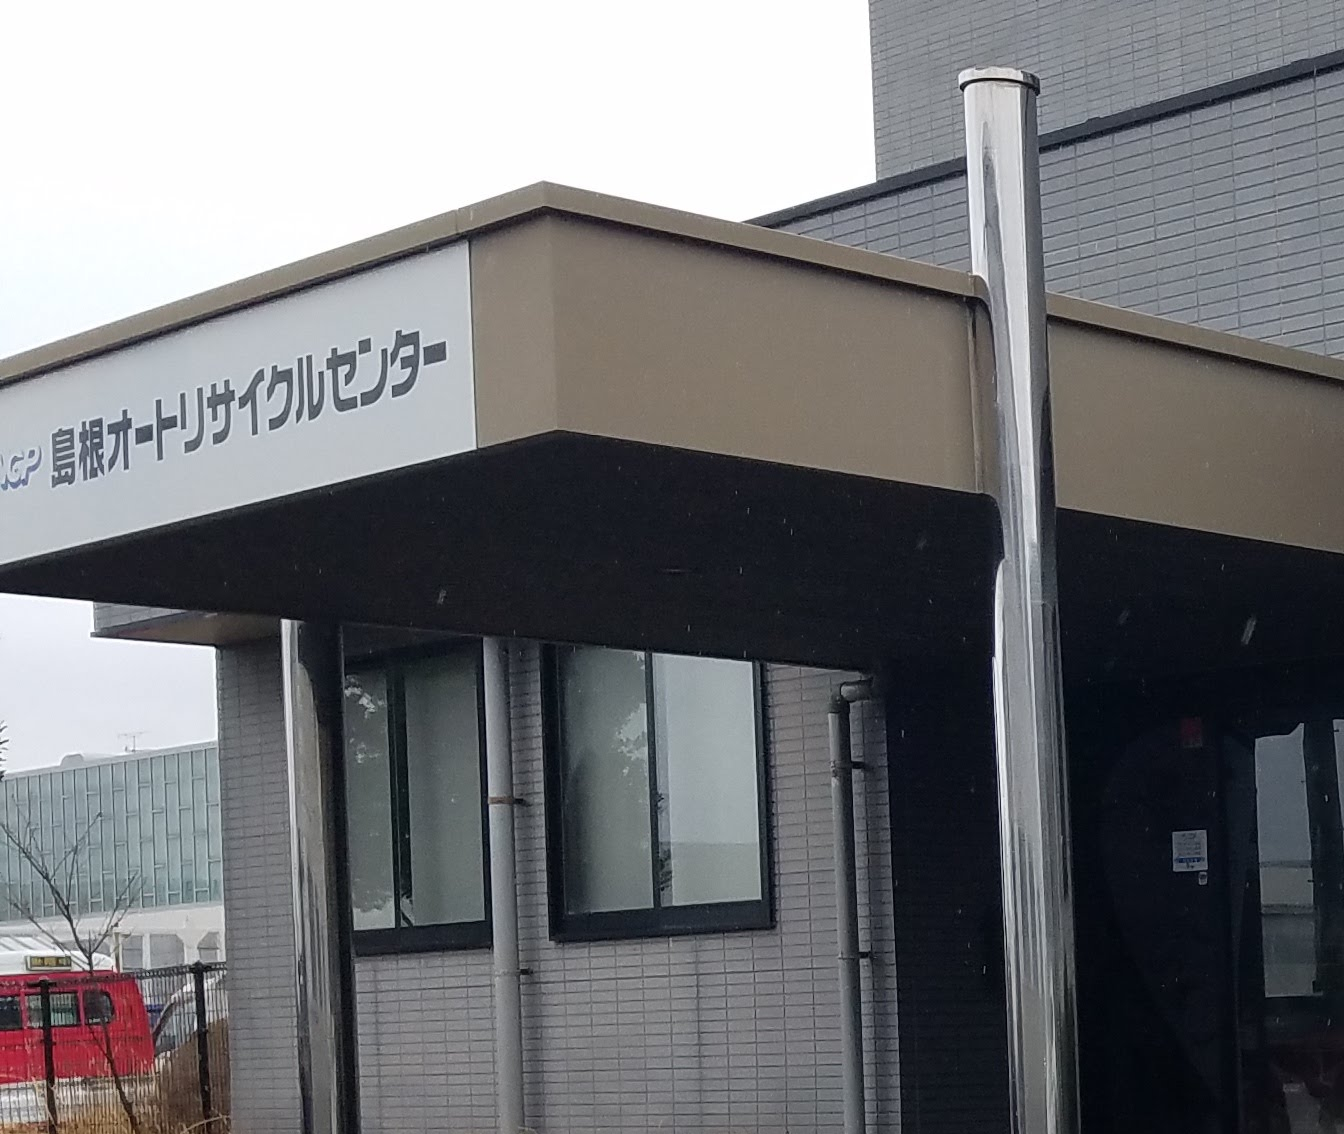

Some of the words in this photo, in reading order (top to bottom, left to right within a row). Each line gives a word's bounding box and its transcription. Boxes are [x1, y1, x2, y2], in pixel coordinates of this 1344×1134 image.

[51, 329, 447, 488] 島根オートリサイクルセンター
